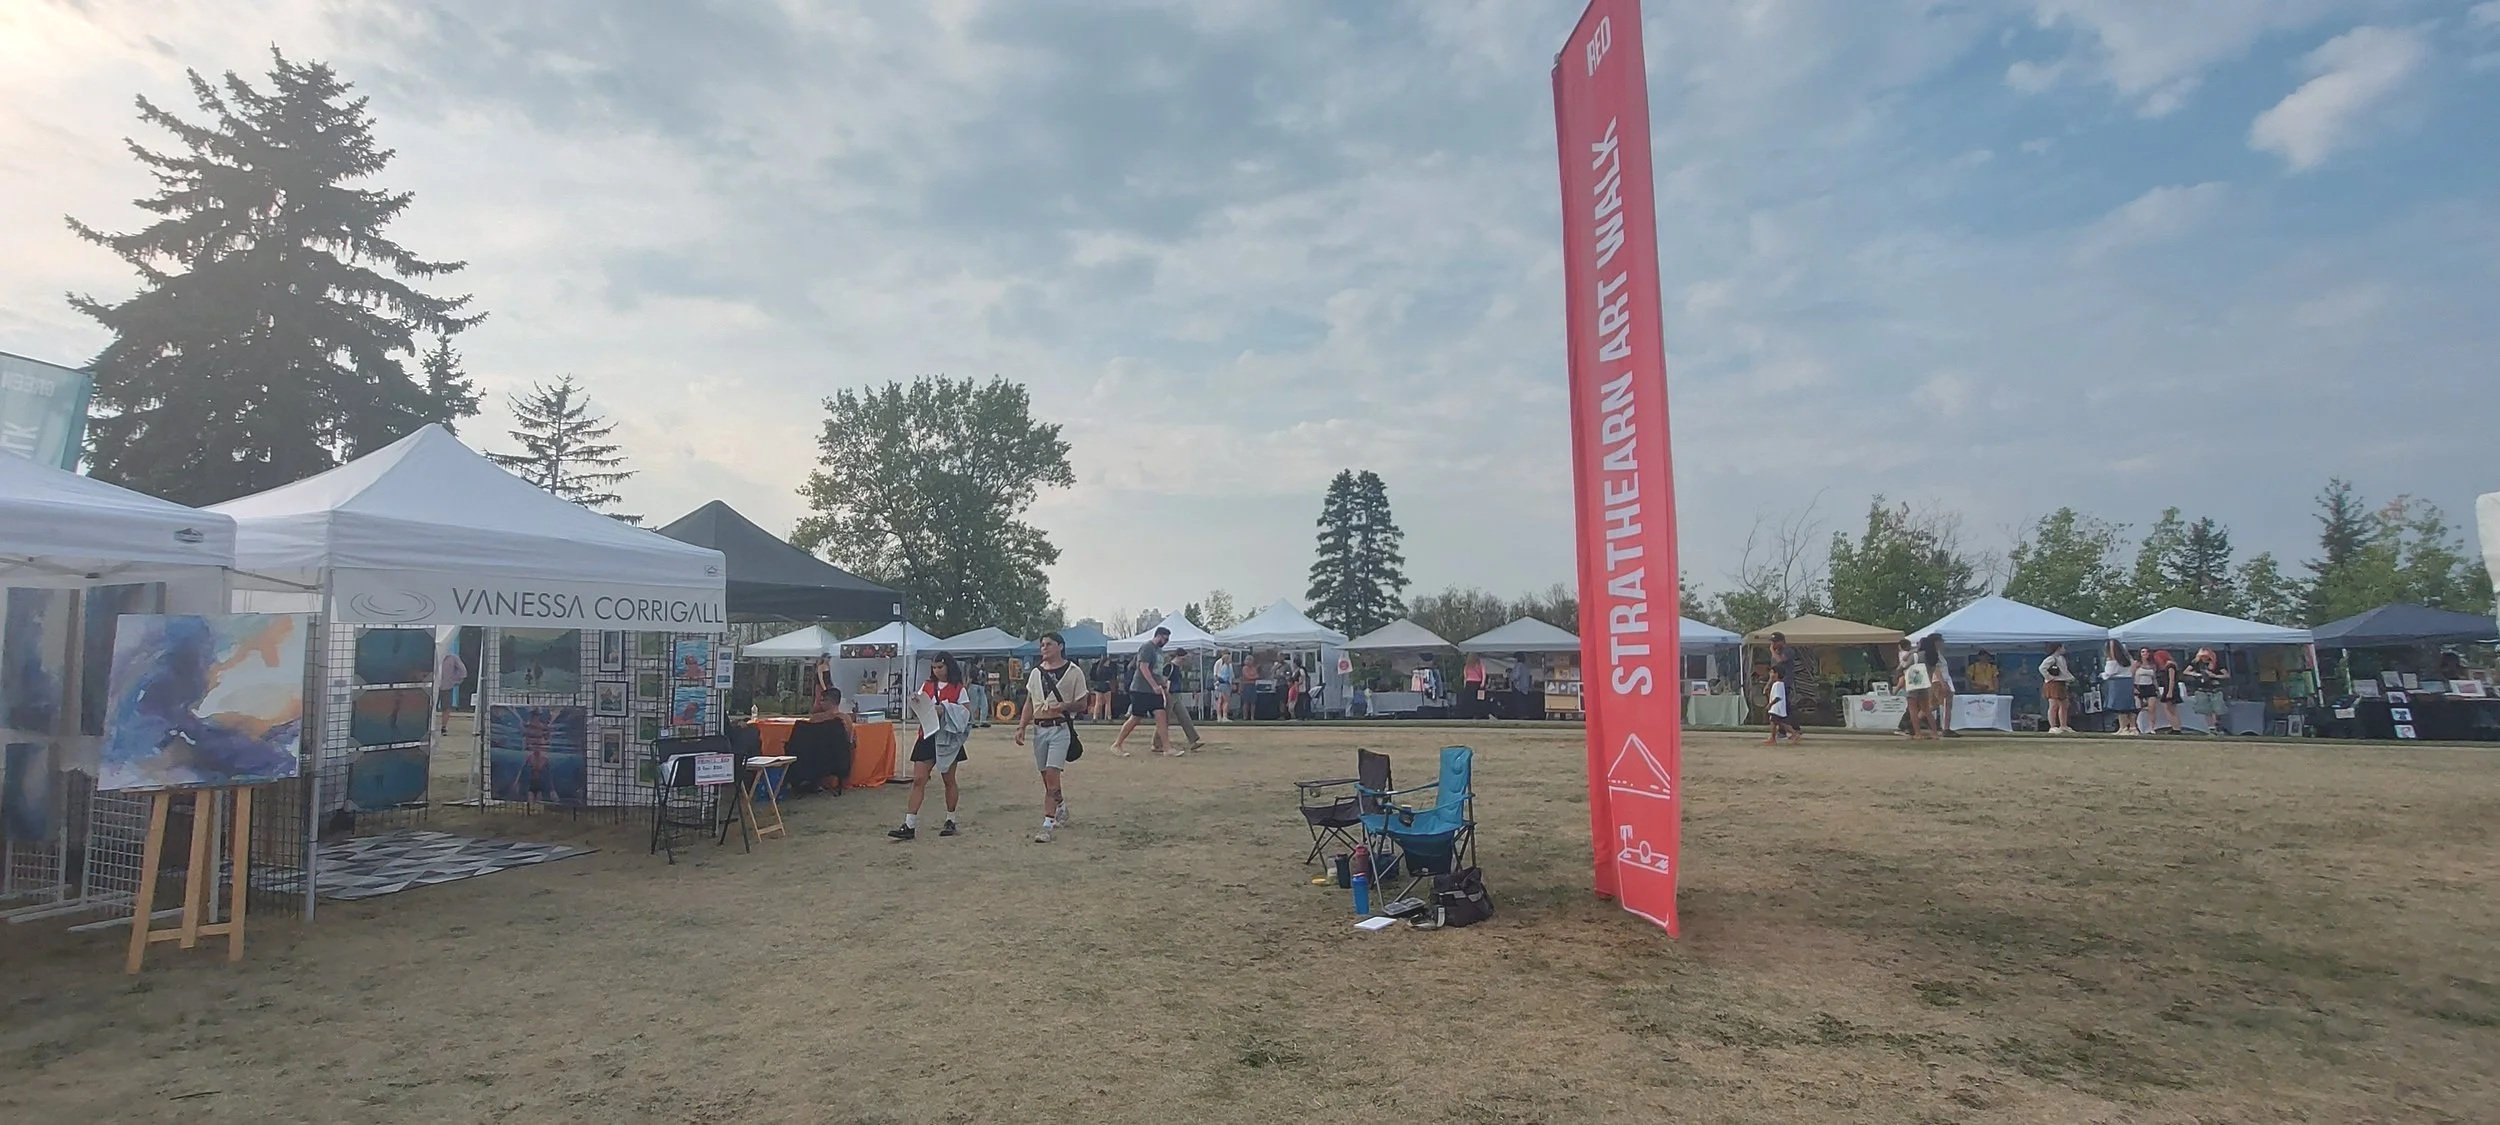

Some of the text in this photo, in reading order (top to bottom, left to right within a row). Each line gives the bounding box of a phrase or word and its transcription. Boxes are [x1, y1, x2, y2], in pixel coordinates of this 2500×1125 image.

[1586, 15, 1611, 77] RED
[1591, 115, 1653, 696] STRATHEARN ART WALK
[452, 587, 724, 624] VANESSA CORRIGALL
